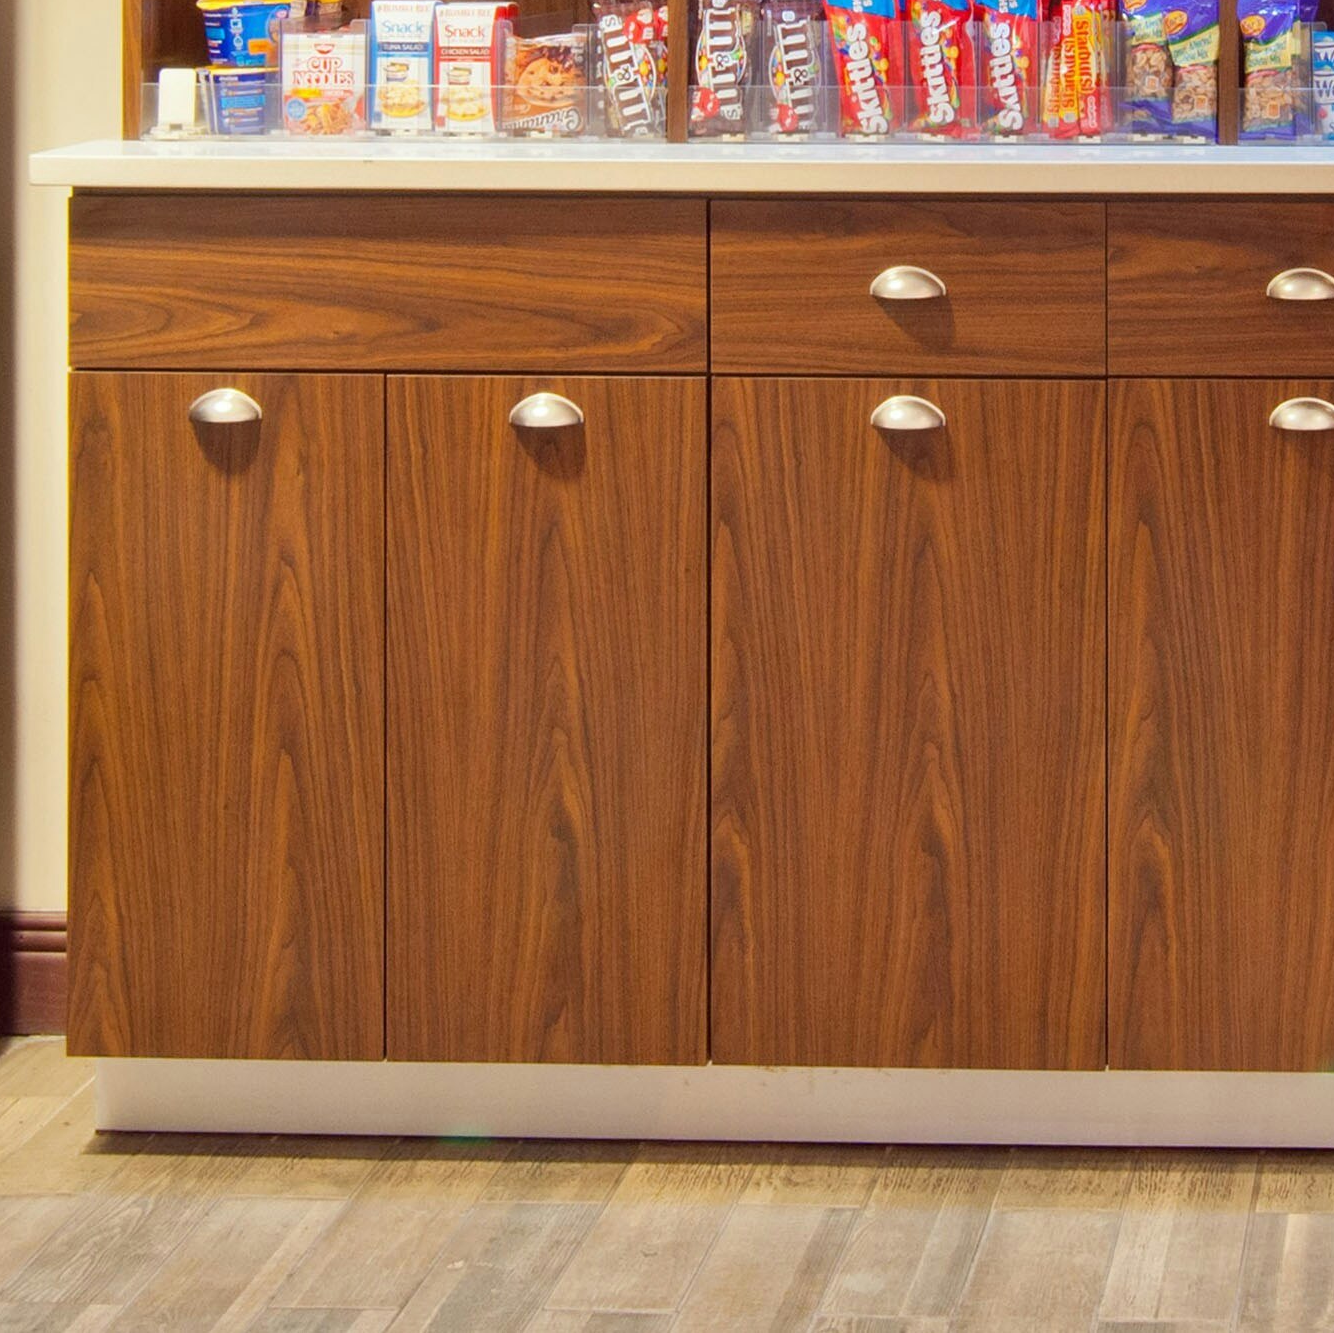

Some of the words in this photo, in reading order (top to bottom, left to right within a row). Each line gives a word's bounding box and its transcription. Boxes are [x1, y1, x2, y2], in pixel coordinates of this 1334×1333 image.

[382, 21, 424, 33] Snack
[444, 25, 485, 38] Snack
[920, 10, 956, 125] Skittles
[1075, 19, 1096, 94] Starburst
[845, 22, 889, 135] Skittles
[989, 22, 1025, 131] Skittles
